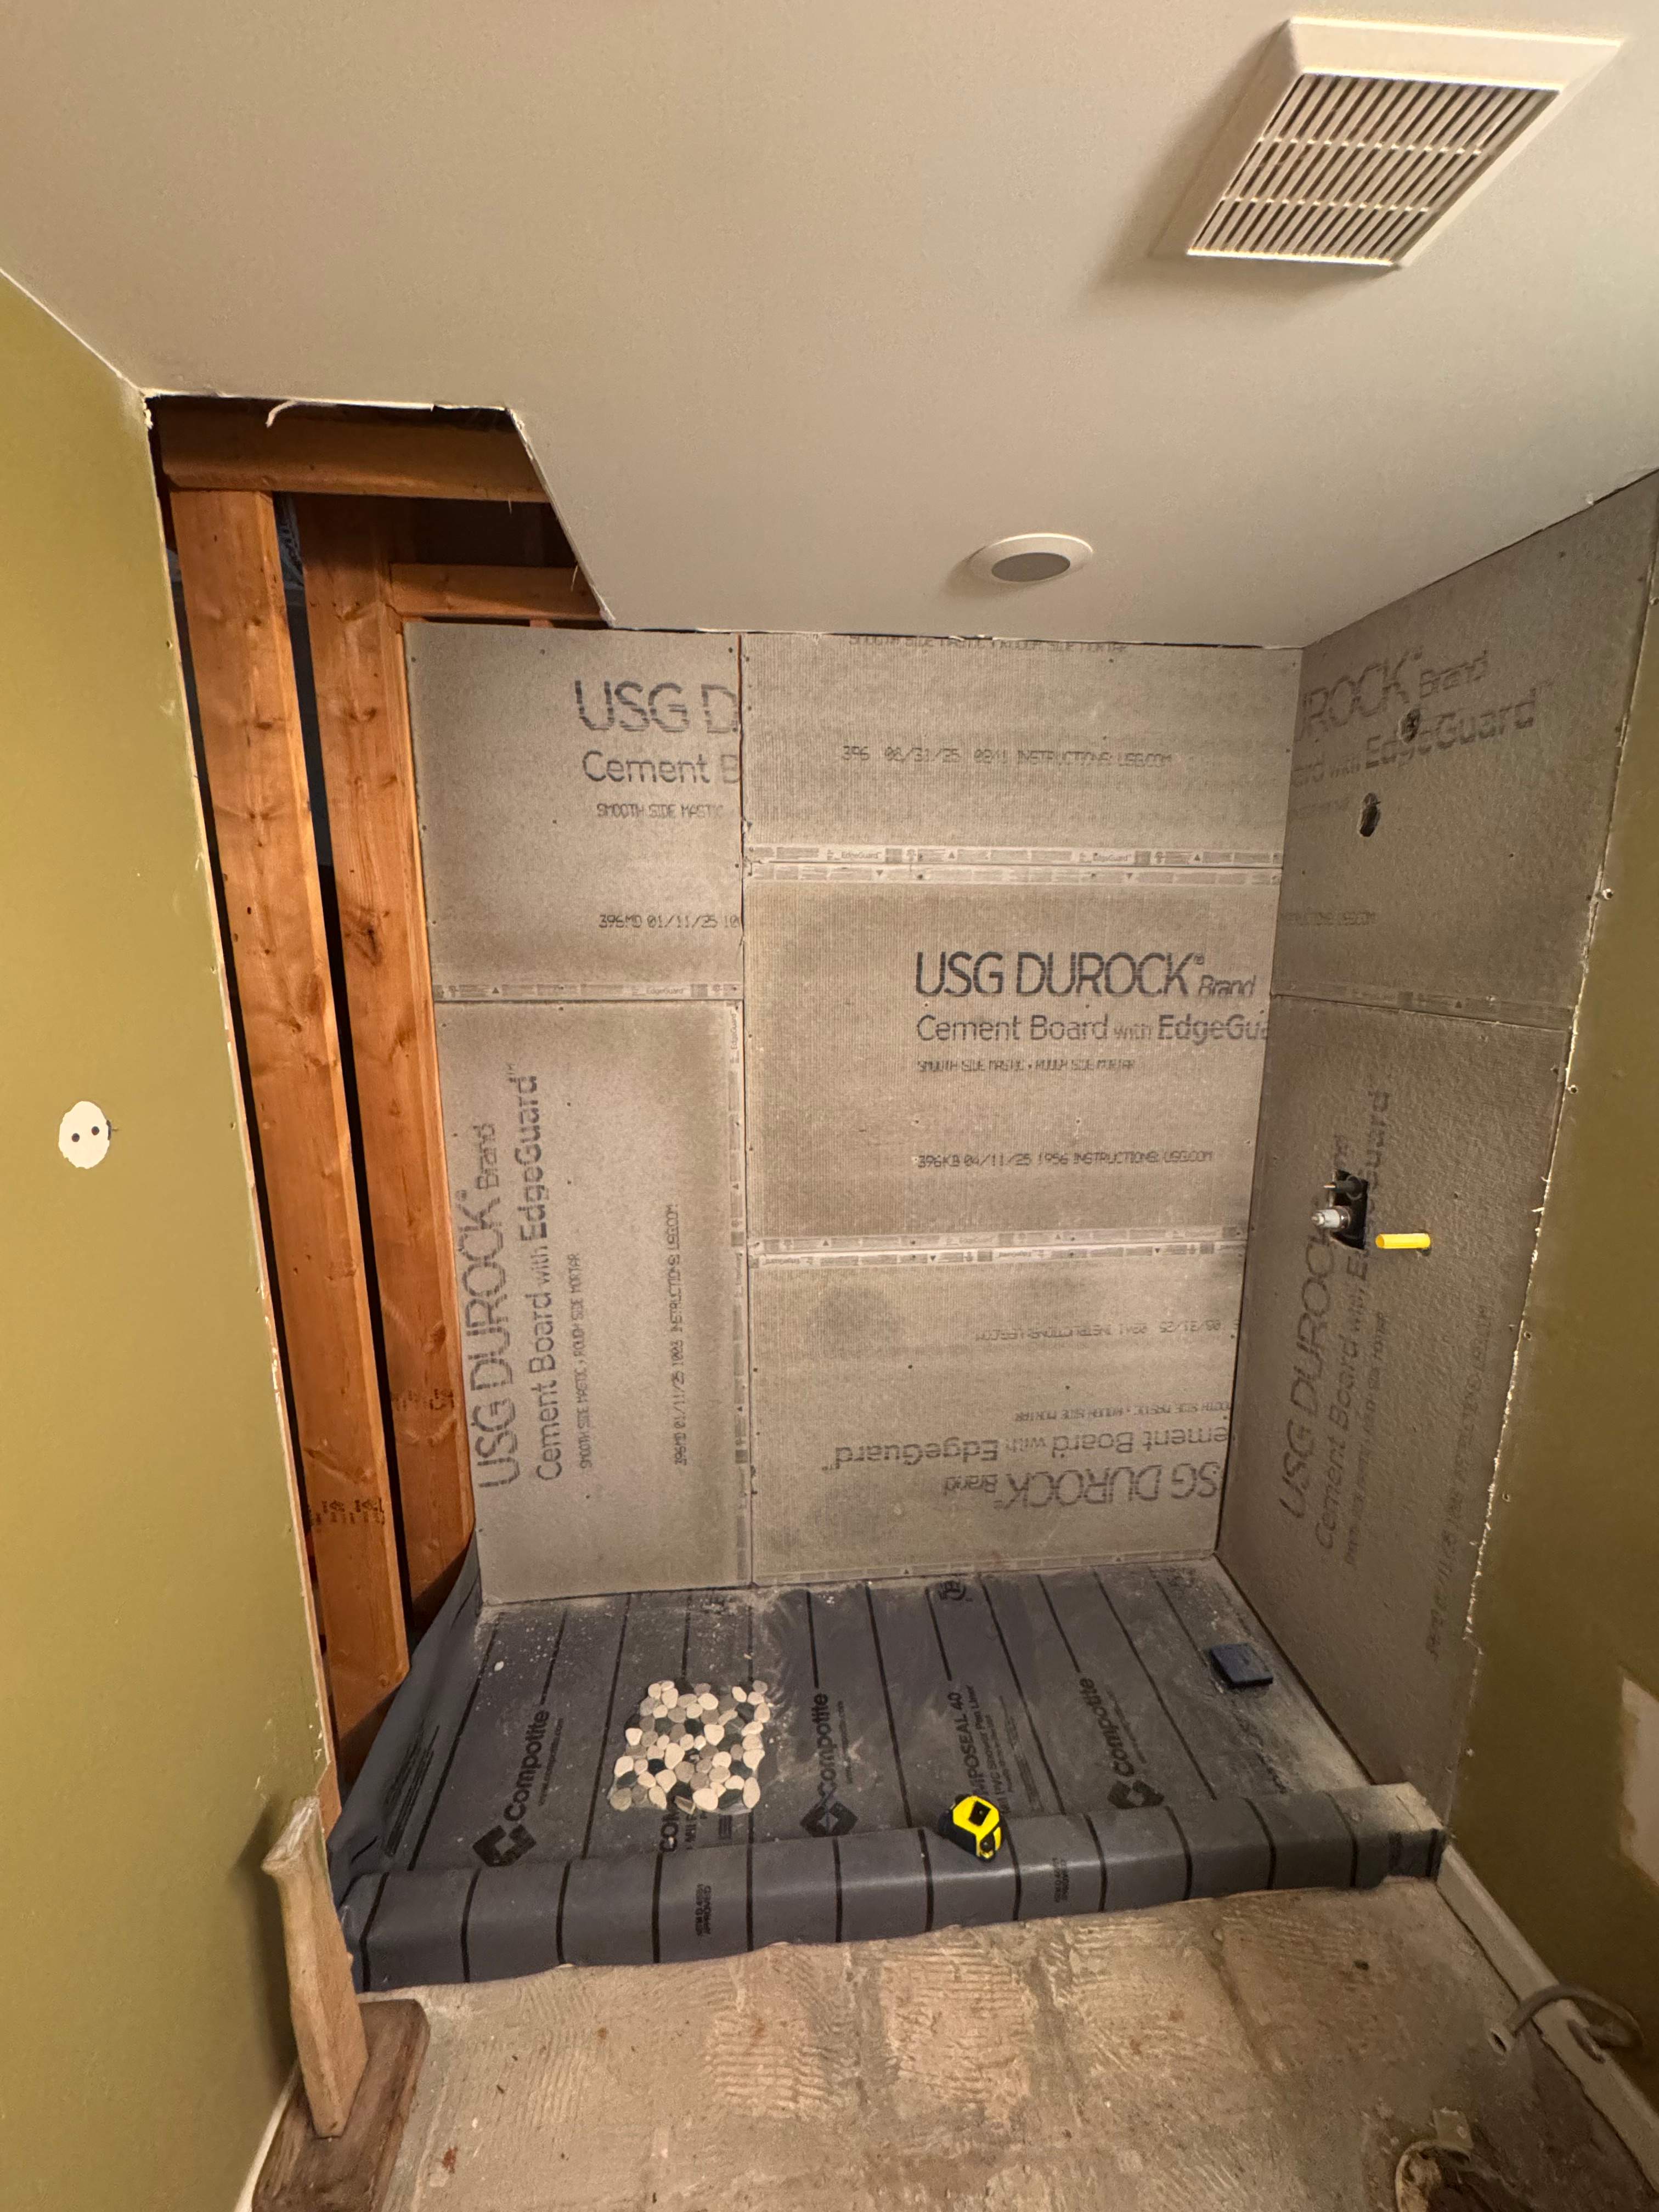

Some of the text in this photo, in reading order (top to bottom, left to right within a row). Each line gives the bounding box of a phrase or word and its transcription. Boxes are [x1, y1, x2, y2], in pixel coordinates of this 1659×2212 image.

[1419, 650, 1488, 699] Brand
[575, 680, 738, 734] USG D
[582, 749, 710, 783] Cement
[843, 746, 869, 761] 396
[596, 803, 644, 819] SMOOTH
[648, 804, 676, 819] SIDE
[647, 915, 718, 928] 01/11/25
[916, 951, 1005, 997] USG
[1197, 975, 1257, 997] Brand
[917, 1013, 1022, 1042] Cement
[1030, 1013, 1108, 1041] Board
[1113, 1025, 1152, 1041] with
[472, 1124, 499, 1190] Brand
[530, 1246, 551, 1287] with
[570, 1298, 583, 1321] SIDE
[523, 1293, 555, 1373] Board
[1329, 1334, 1358, 1432] Board
[530, 1380, 562, 1481] Cement
[576, 1406, 590, 1429] SIDE
[1142, 1427, 1229, 1452] ement
[472, 1398, 520, 1488] USG
[1052, 1432, 1133, 1459] Board
[944, 1474, 998, 1497] Brand
[1279, 1419, 1314, 1519] USG
[1316, 1435, 1346, 1550] Cement
[947, 1691, 963, 1711] 40
[810, 1694, 837, 1798] Compotite
[1079, 1678, 1135, 1776] Compotite
[503, 1710, 549, 1821] Compotite
